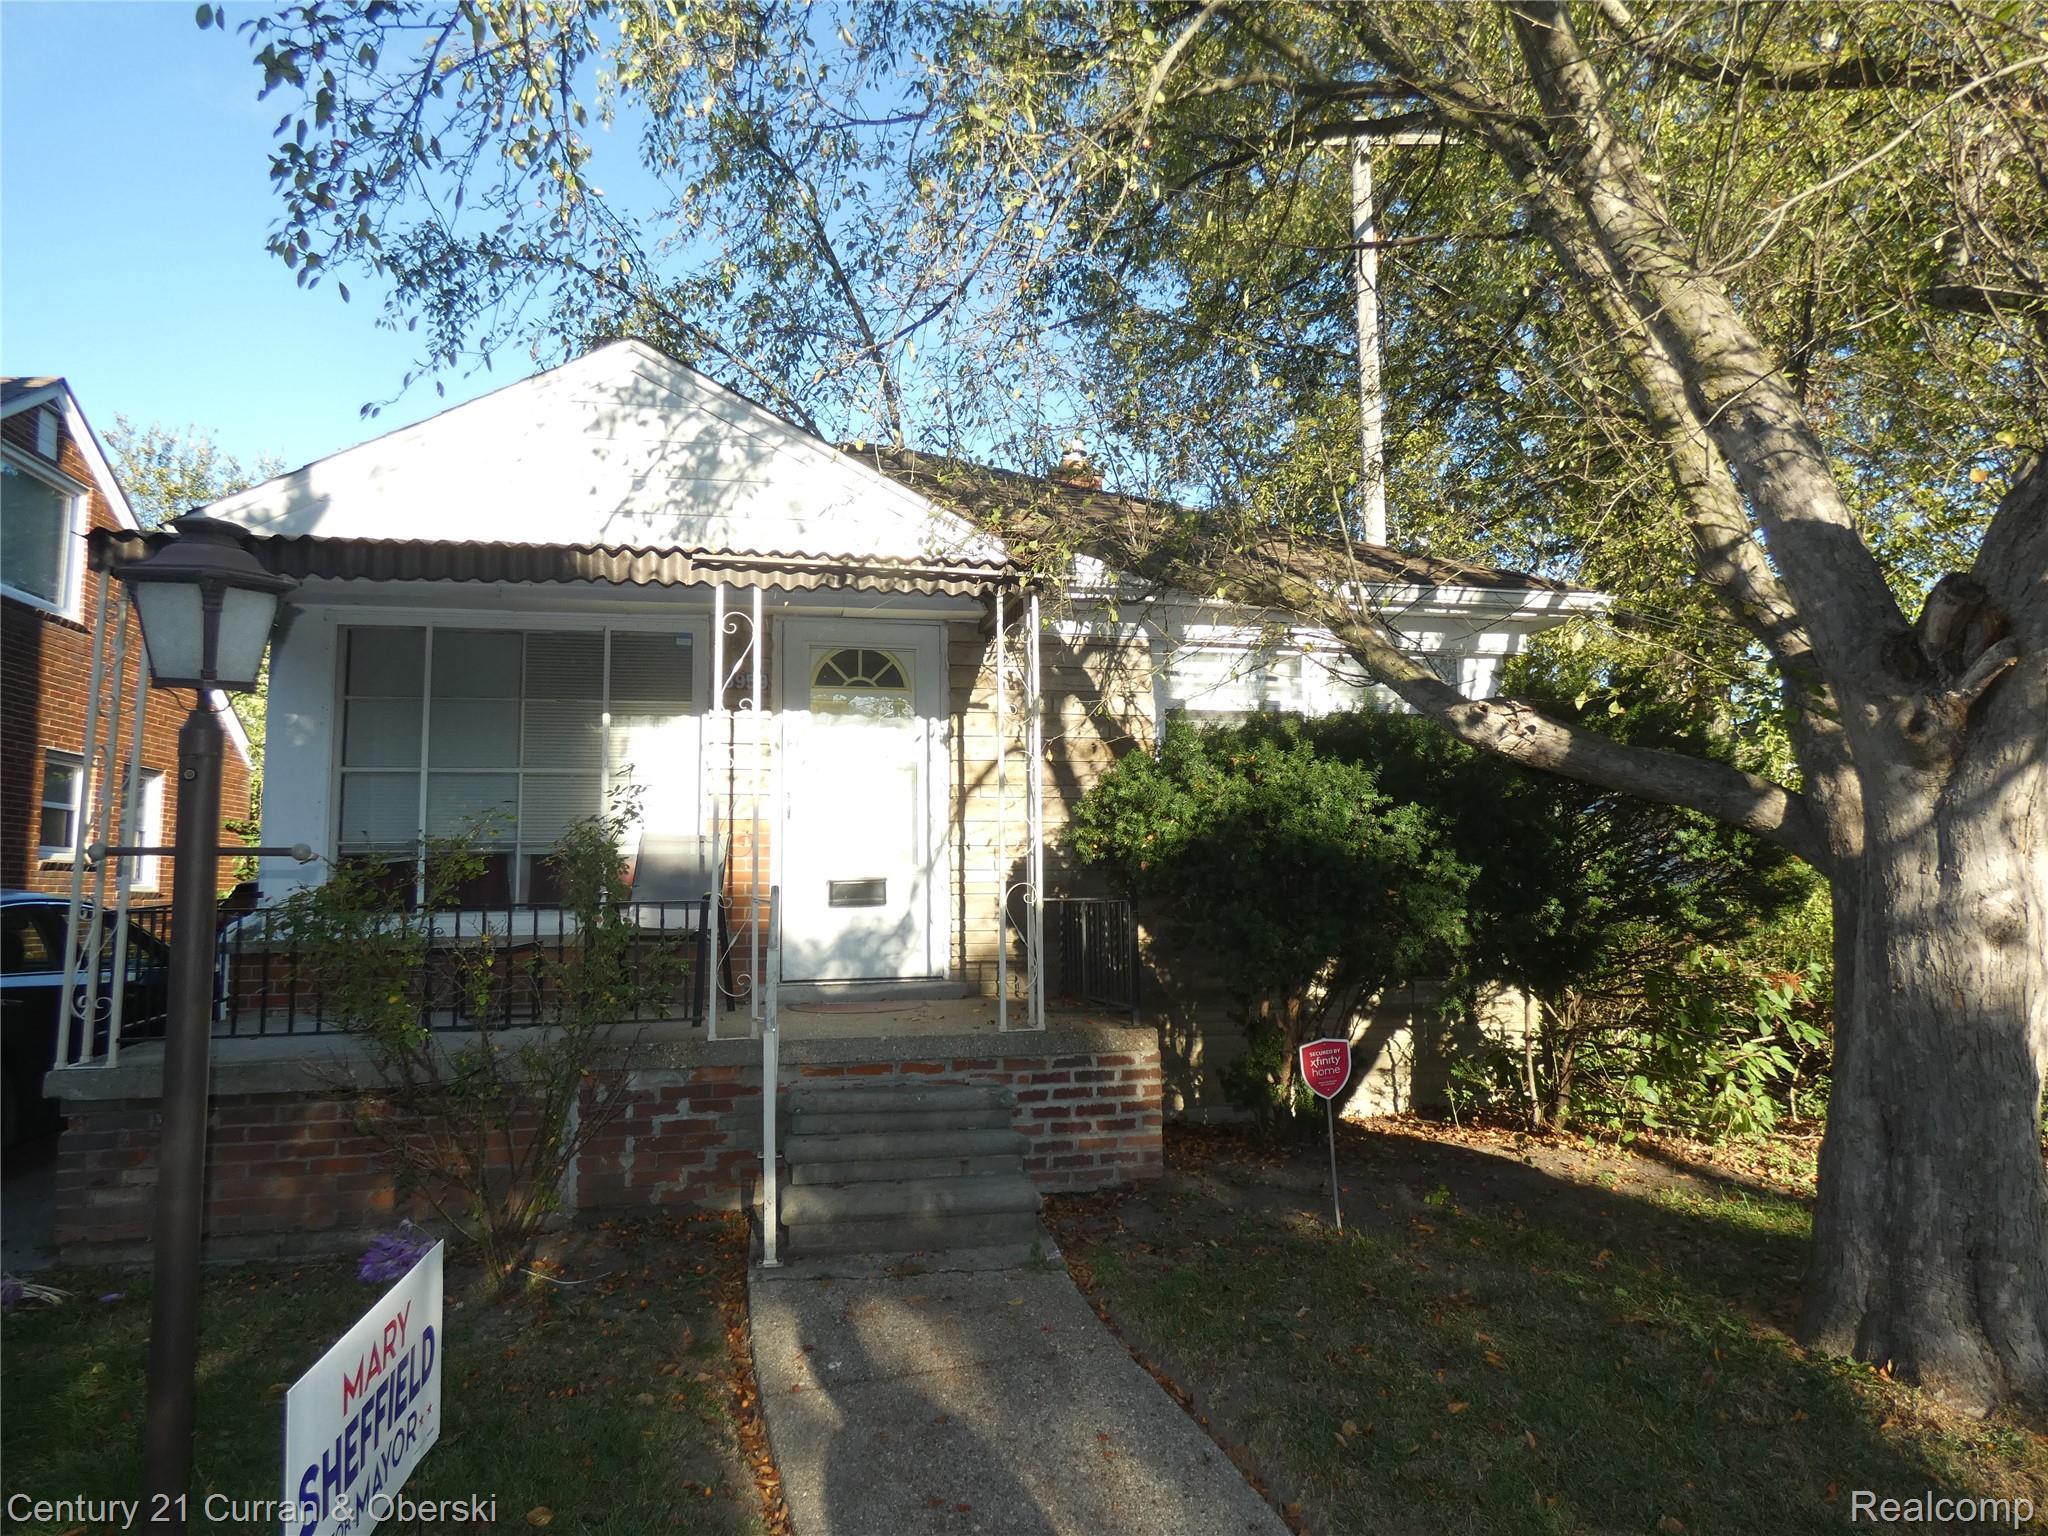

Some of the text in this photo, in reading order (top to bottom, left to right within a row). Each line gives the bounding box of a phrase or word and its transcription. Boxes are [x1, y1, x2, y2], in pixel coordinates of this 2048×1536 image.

[1308, 1049, 1333, 1057] SECURED
[1310, 1055, 1341, 1069] xfinity
[1312, 1066, 1341, 1077] home
[343, 1300, 412, 1417] MARY
[298, 1325, 436, 1536] SHEFFIELD
[356, 1410, 417, 1528] MAYOR
